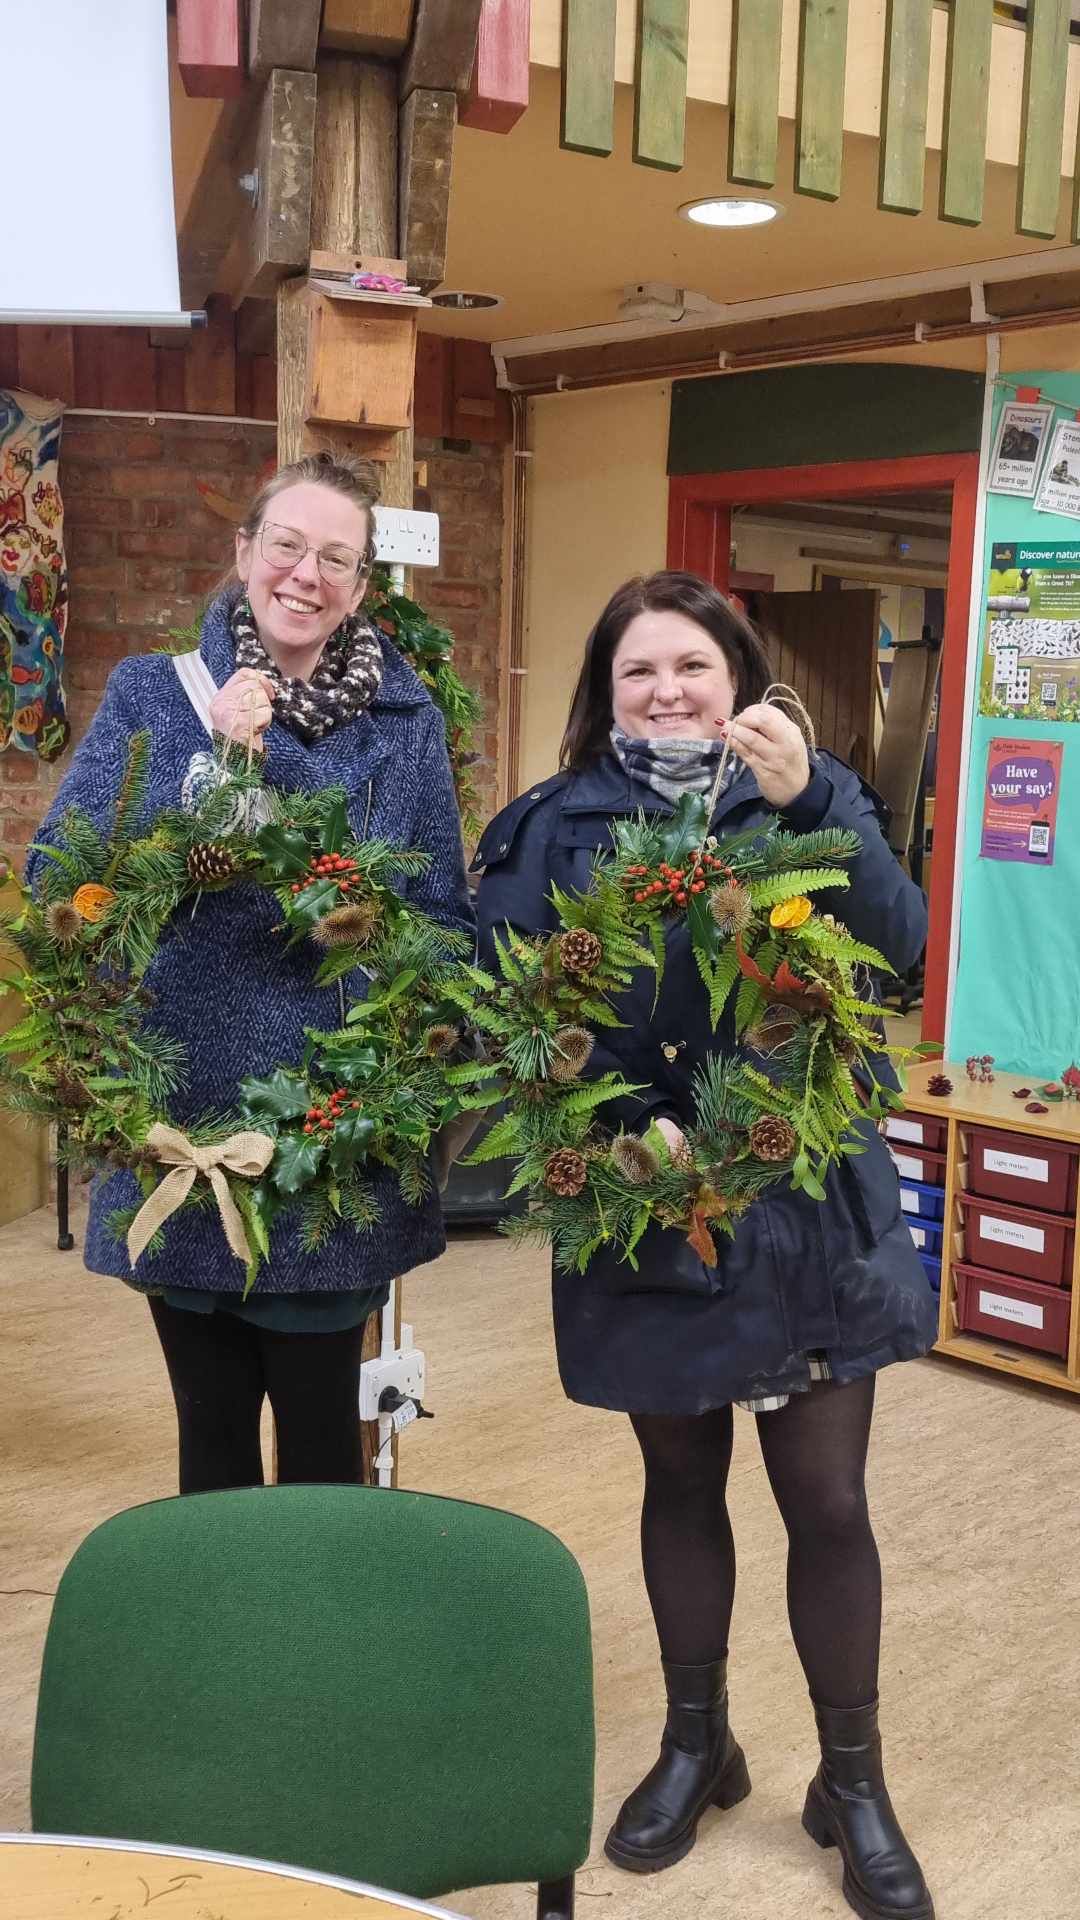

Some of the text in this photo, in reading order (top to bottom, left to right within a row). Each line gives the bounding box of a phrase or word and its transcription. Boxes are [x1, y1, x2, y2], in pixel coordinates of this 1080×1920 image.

[1062, 432, 1080, 442] Ston
[1011, 464, 1033, 473] million
[997, 477, 1016, 485] years
[1020, 550, 1055, 560] Discover
[1006, 764, 1038, 778] Have
[991, 782, 1052, 798] your say!
